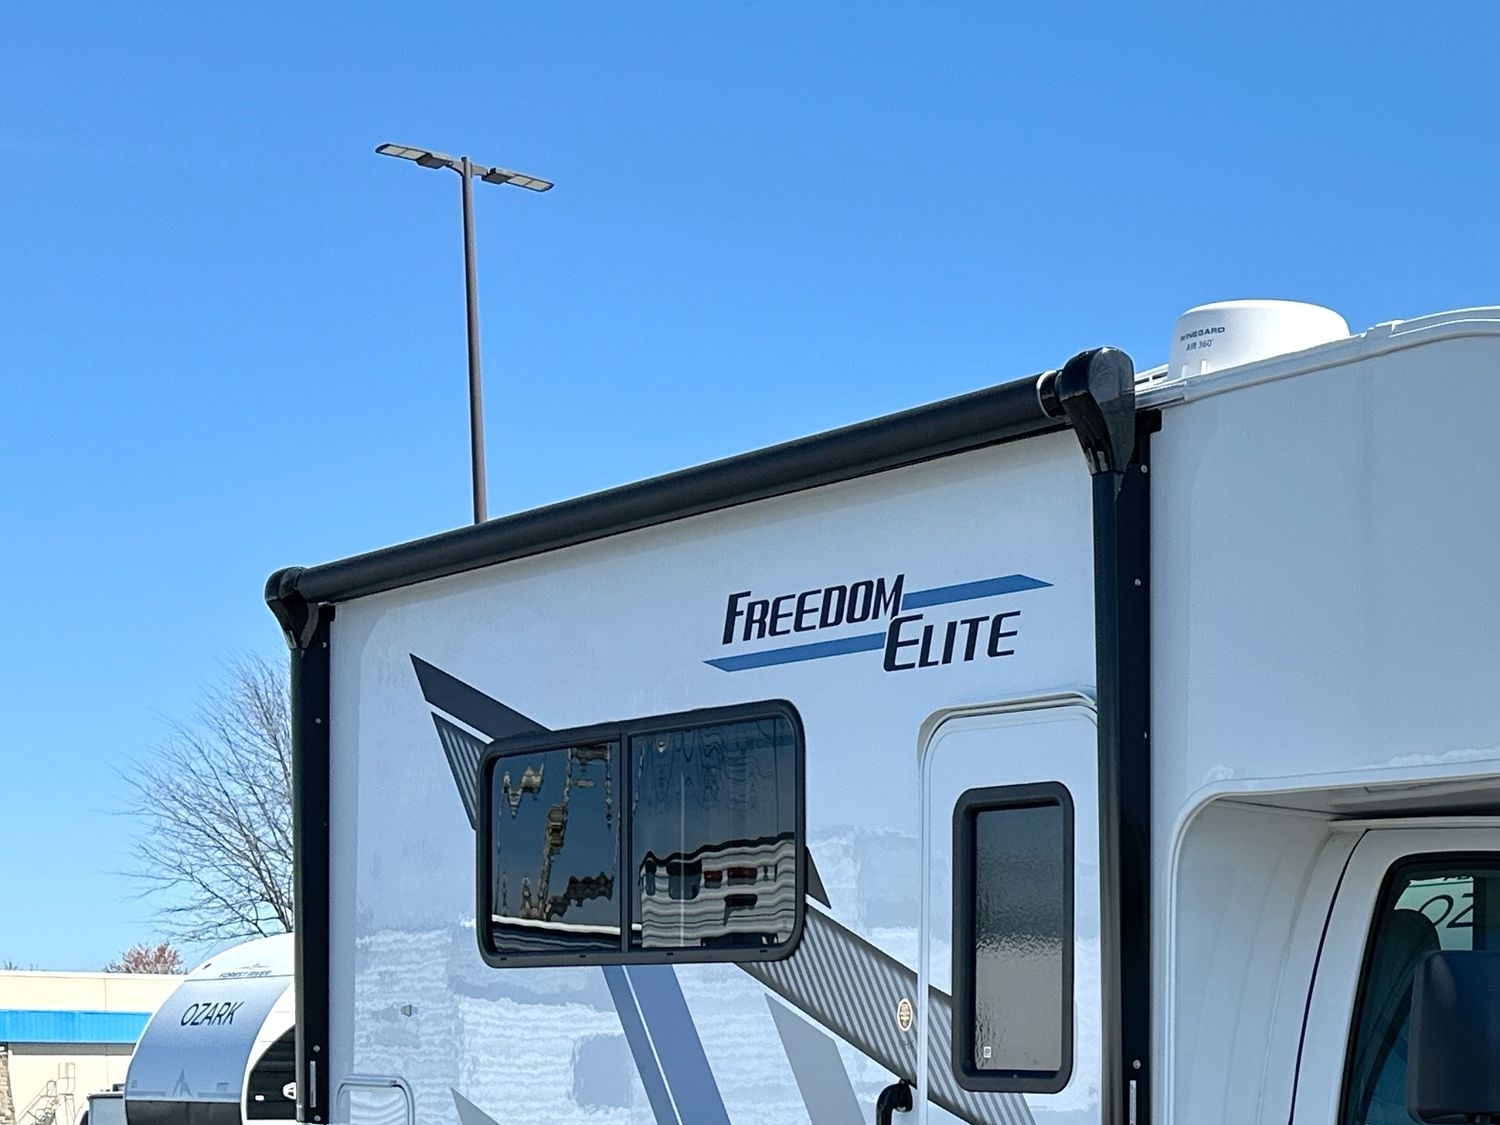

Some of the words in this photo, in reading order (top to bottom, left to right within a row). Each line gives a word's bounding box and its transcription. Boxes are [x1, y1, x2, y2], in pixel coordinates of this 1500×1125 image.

[722, 573, 905, 645] FREEDOM
[883, 610, 1022, 672] ELITE
[181, 1001, 245, 1027] OZARK
